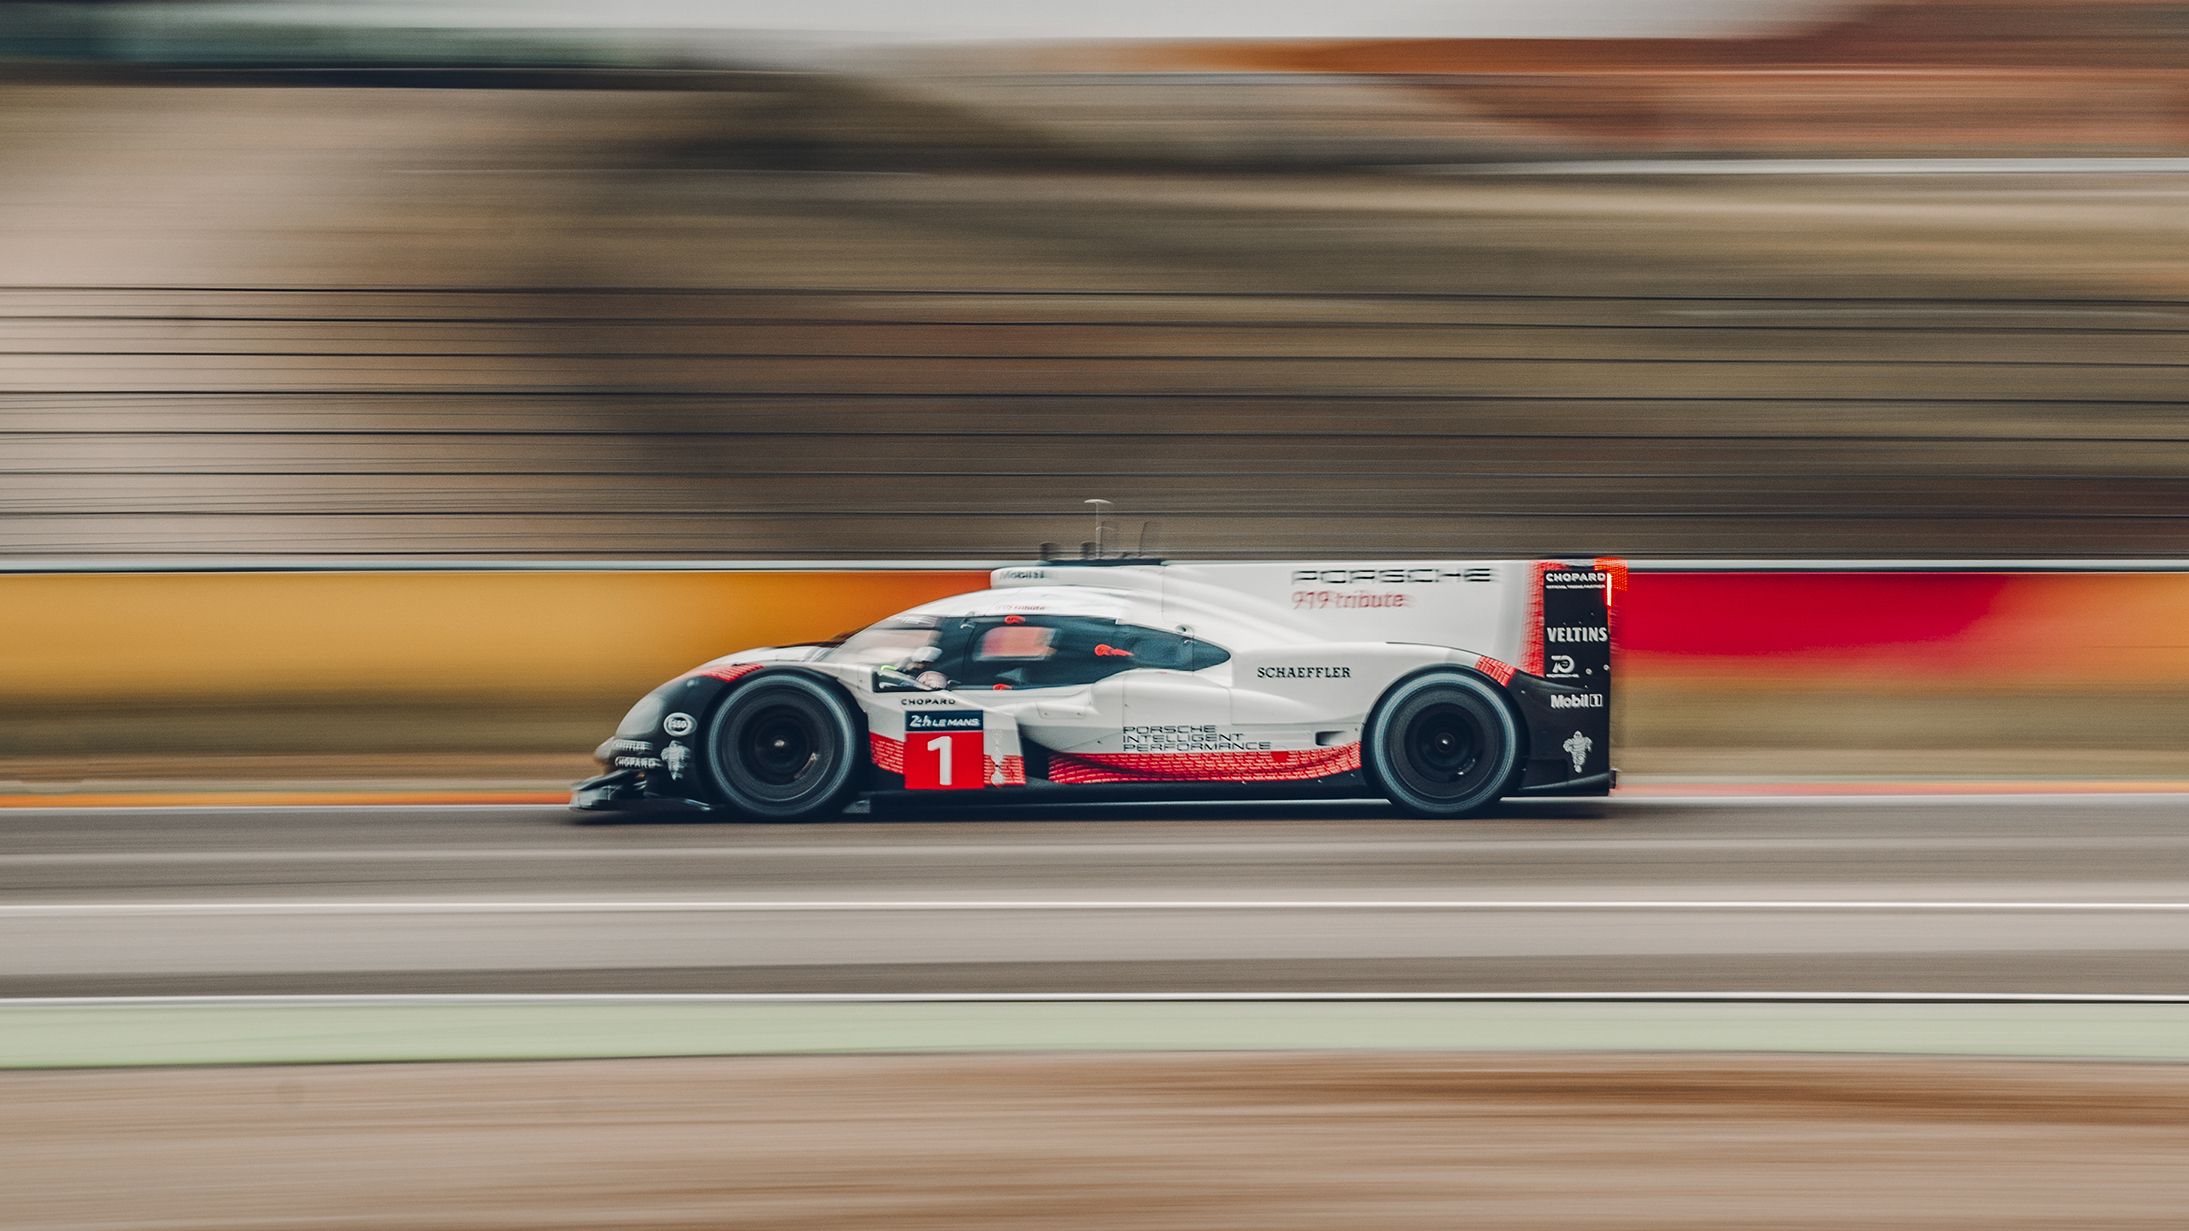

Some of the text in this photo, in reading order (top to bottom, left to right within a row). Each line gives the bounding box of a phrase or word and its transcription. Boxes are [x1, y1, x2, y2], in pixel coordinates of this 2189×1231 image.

[1293, 569, 1497, 584] PORSCHE
[1545, 572, 1606, 582] CHOPARD
[1293, 590, 1410, 609] 919 tribute
[1547, 627, 1608, 642] VELTINS
[1257, 666, 1351, 679] SCHAEFFLER
[932, 717, 947, 727] LE
[947, 718, 980, 727] MANS
[1123, 725, 1216, 735] PORSCHE
[1123, 733, 1244, 744] INTELLIGENT
[1123, 742, 1271, 752] PERFORMANCE
[927, 735, 953, 786] 1
